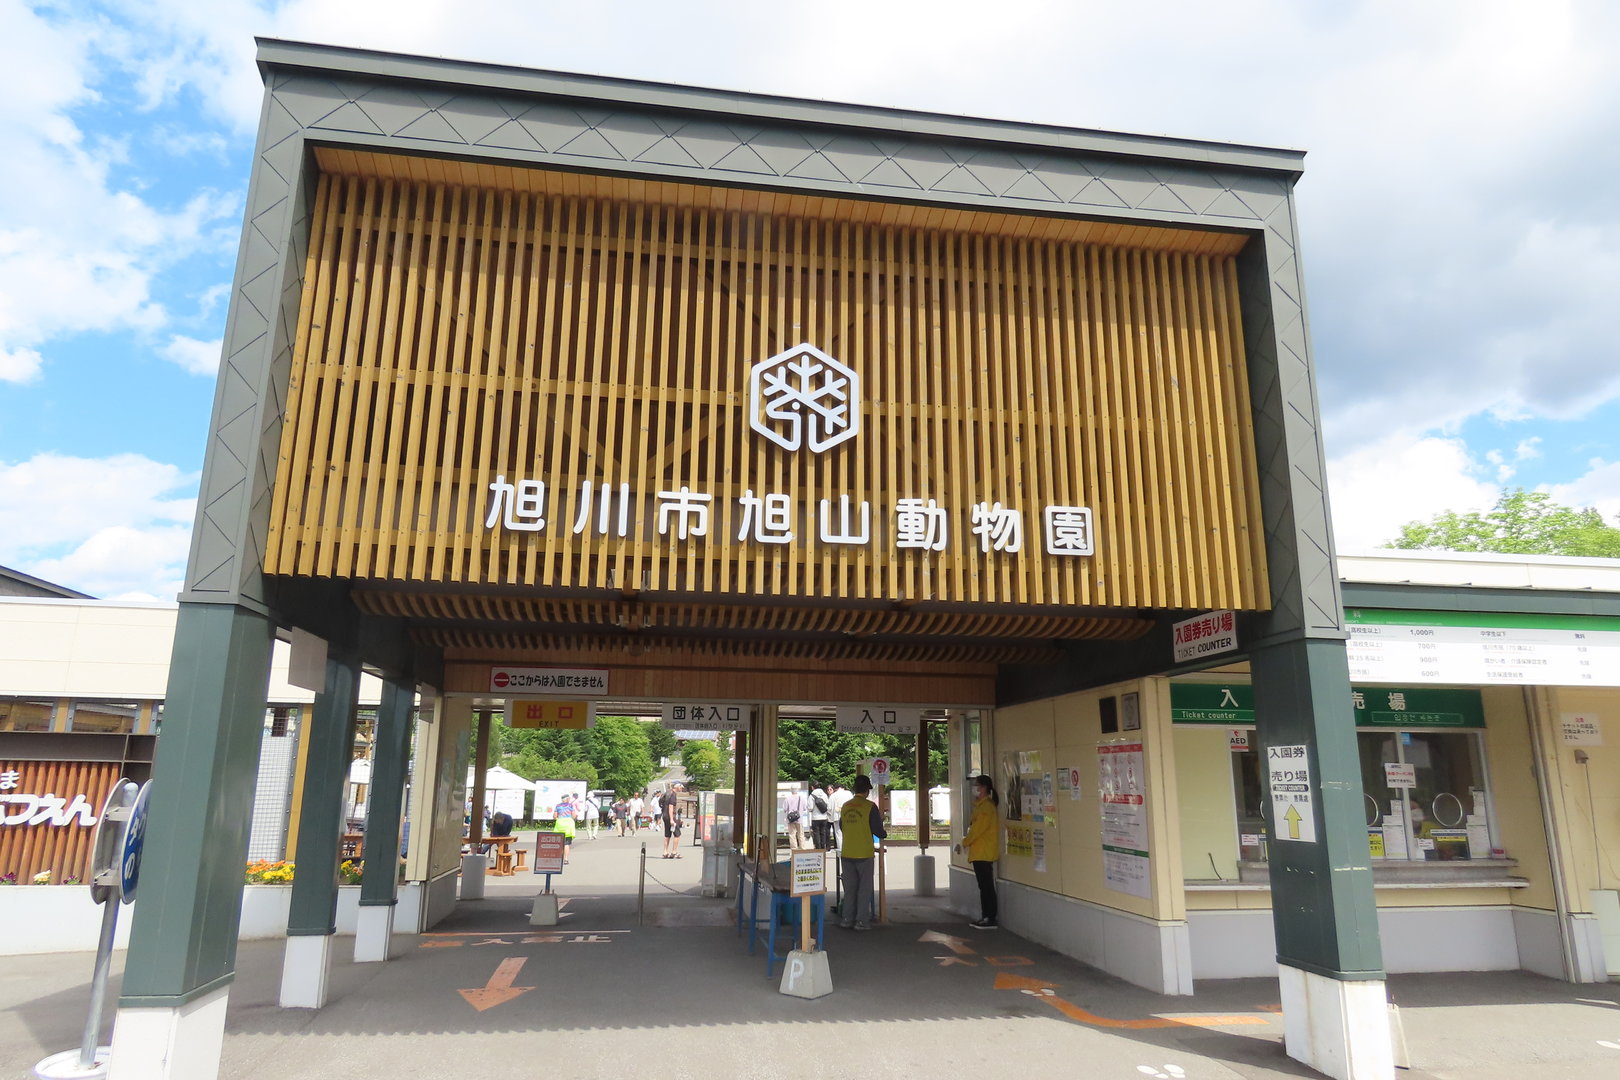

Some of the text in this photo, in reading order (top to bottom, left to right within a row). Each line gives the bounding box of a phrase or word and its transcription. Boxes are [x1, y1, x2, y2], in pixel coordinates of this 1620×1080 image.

[486, 475, 1095, 557] 旭川市旭山動物園
[1175, 612, 1233, 645] 入園券売り場
[1178, 637, 1232, 659] TICKET COUNTER
[510, 674, 604, 688] ここからは入園できません
[526, 704, 574, 720] 出口
[672, 705, 740, 721] 団体入口
[861, 709, 896, 724] 入口
[1182, 711, 1236, 720] Ticket counter
[538, 720, 560, 728] EXIT
[1269, 747, 1305, 759] 入園券
[1271, 770, 1308, 783] 売り場
